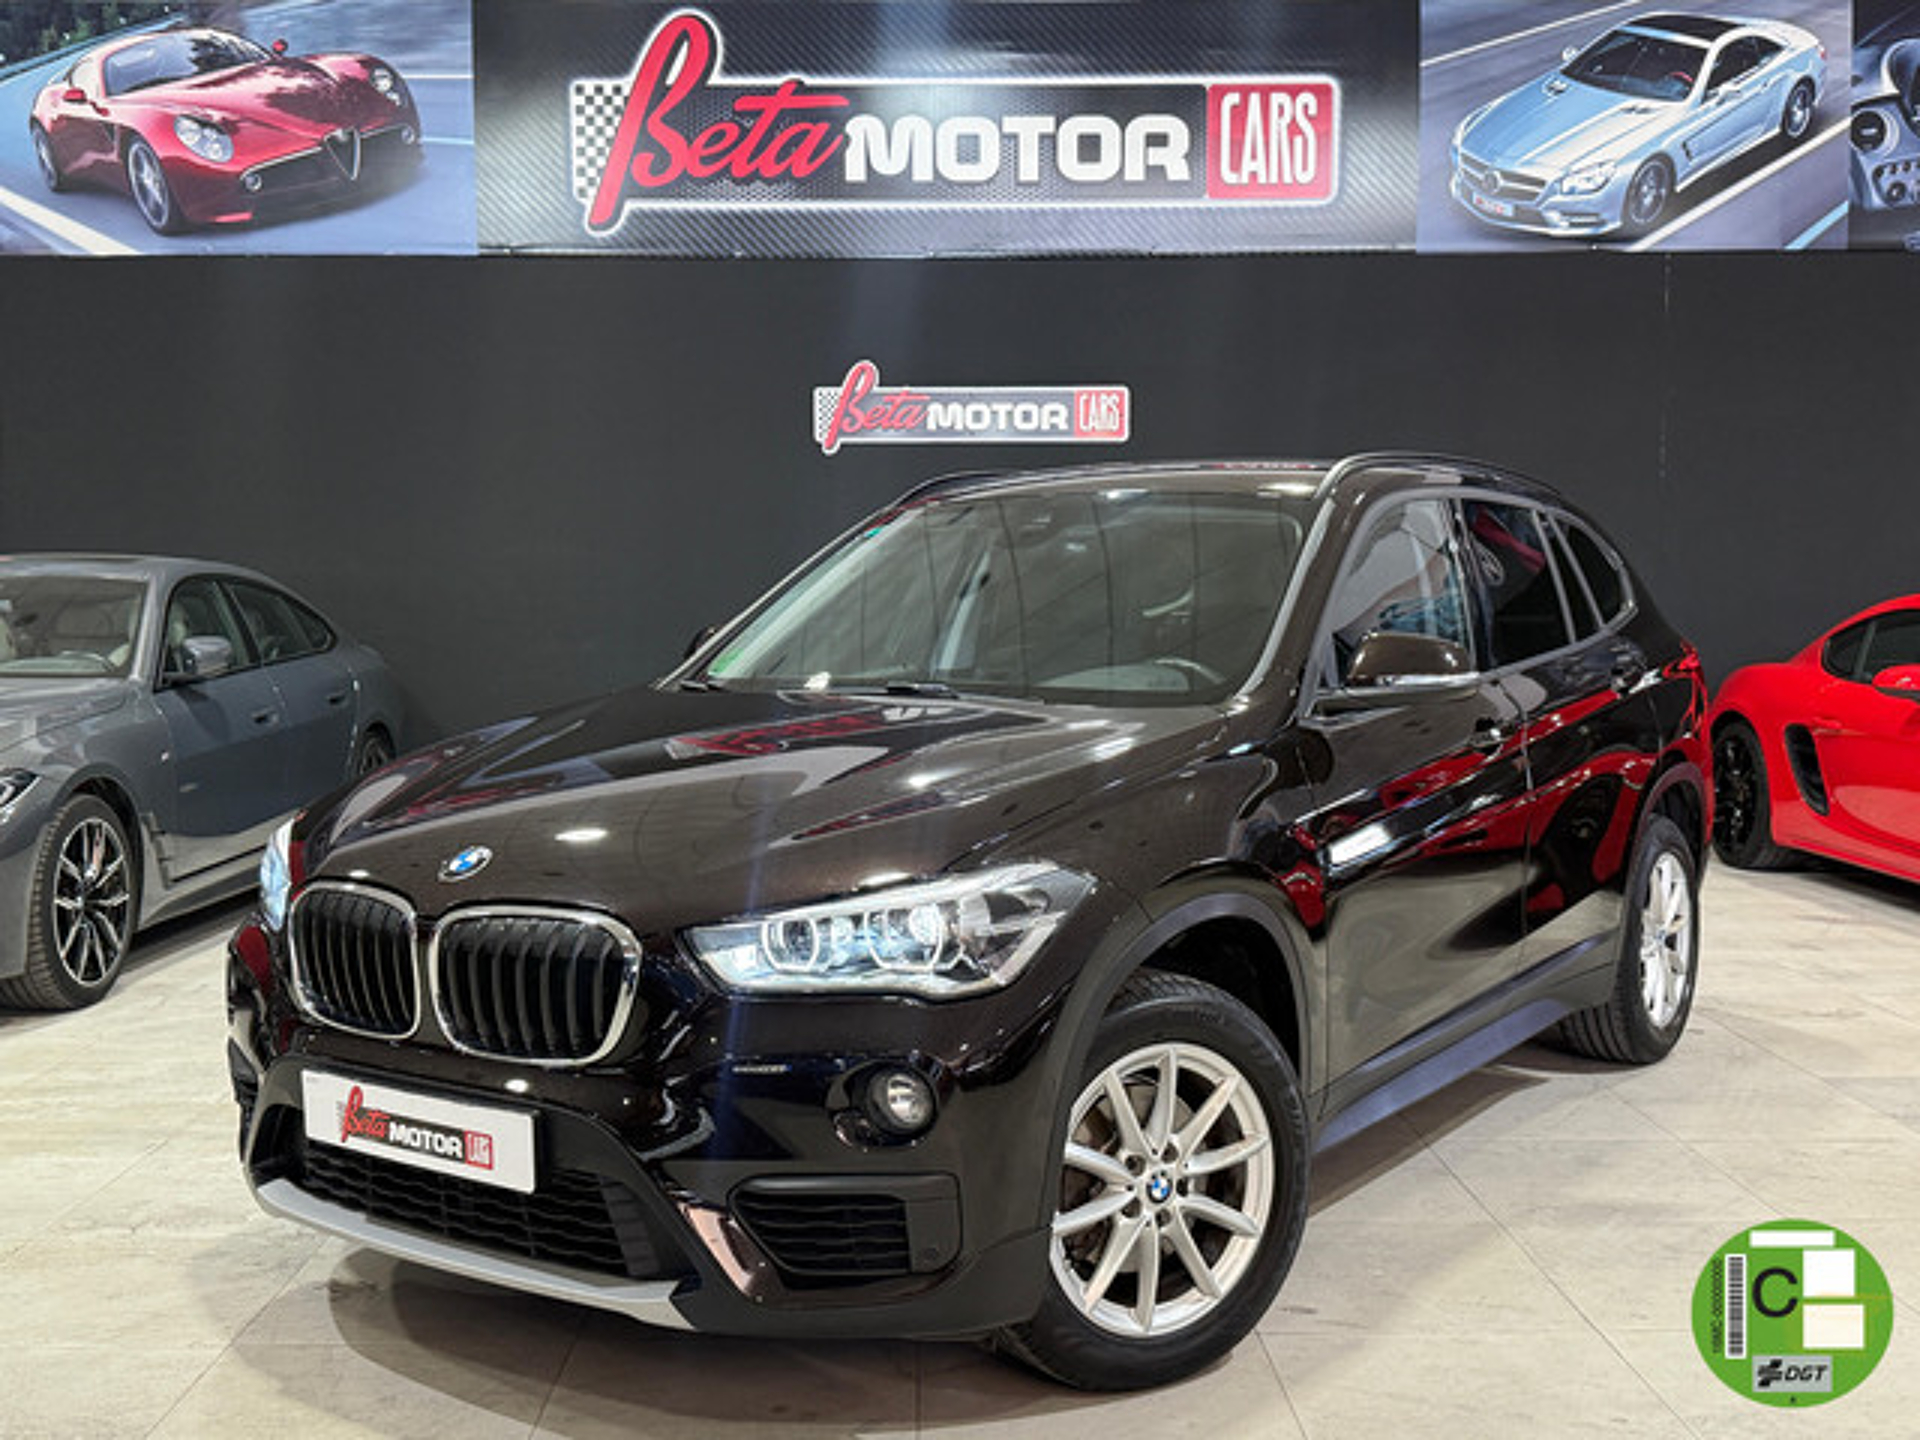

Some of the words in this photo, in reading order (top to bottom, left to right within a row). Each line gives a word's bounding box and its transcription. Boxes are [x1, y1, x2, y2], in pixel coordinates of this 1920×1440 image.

[844, 113, 1191, 183] MOTOR
[1218, 90, 1319, 184] CARS
[926, 402, 1068, 431] MOTOR
[1079, 393, 1120, 432] CARS
[389, 1121, 463, 1159] MOTOR
